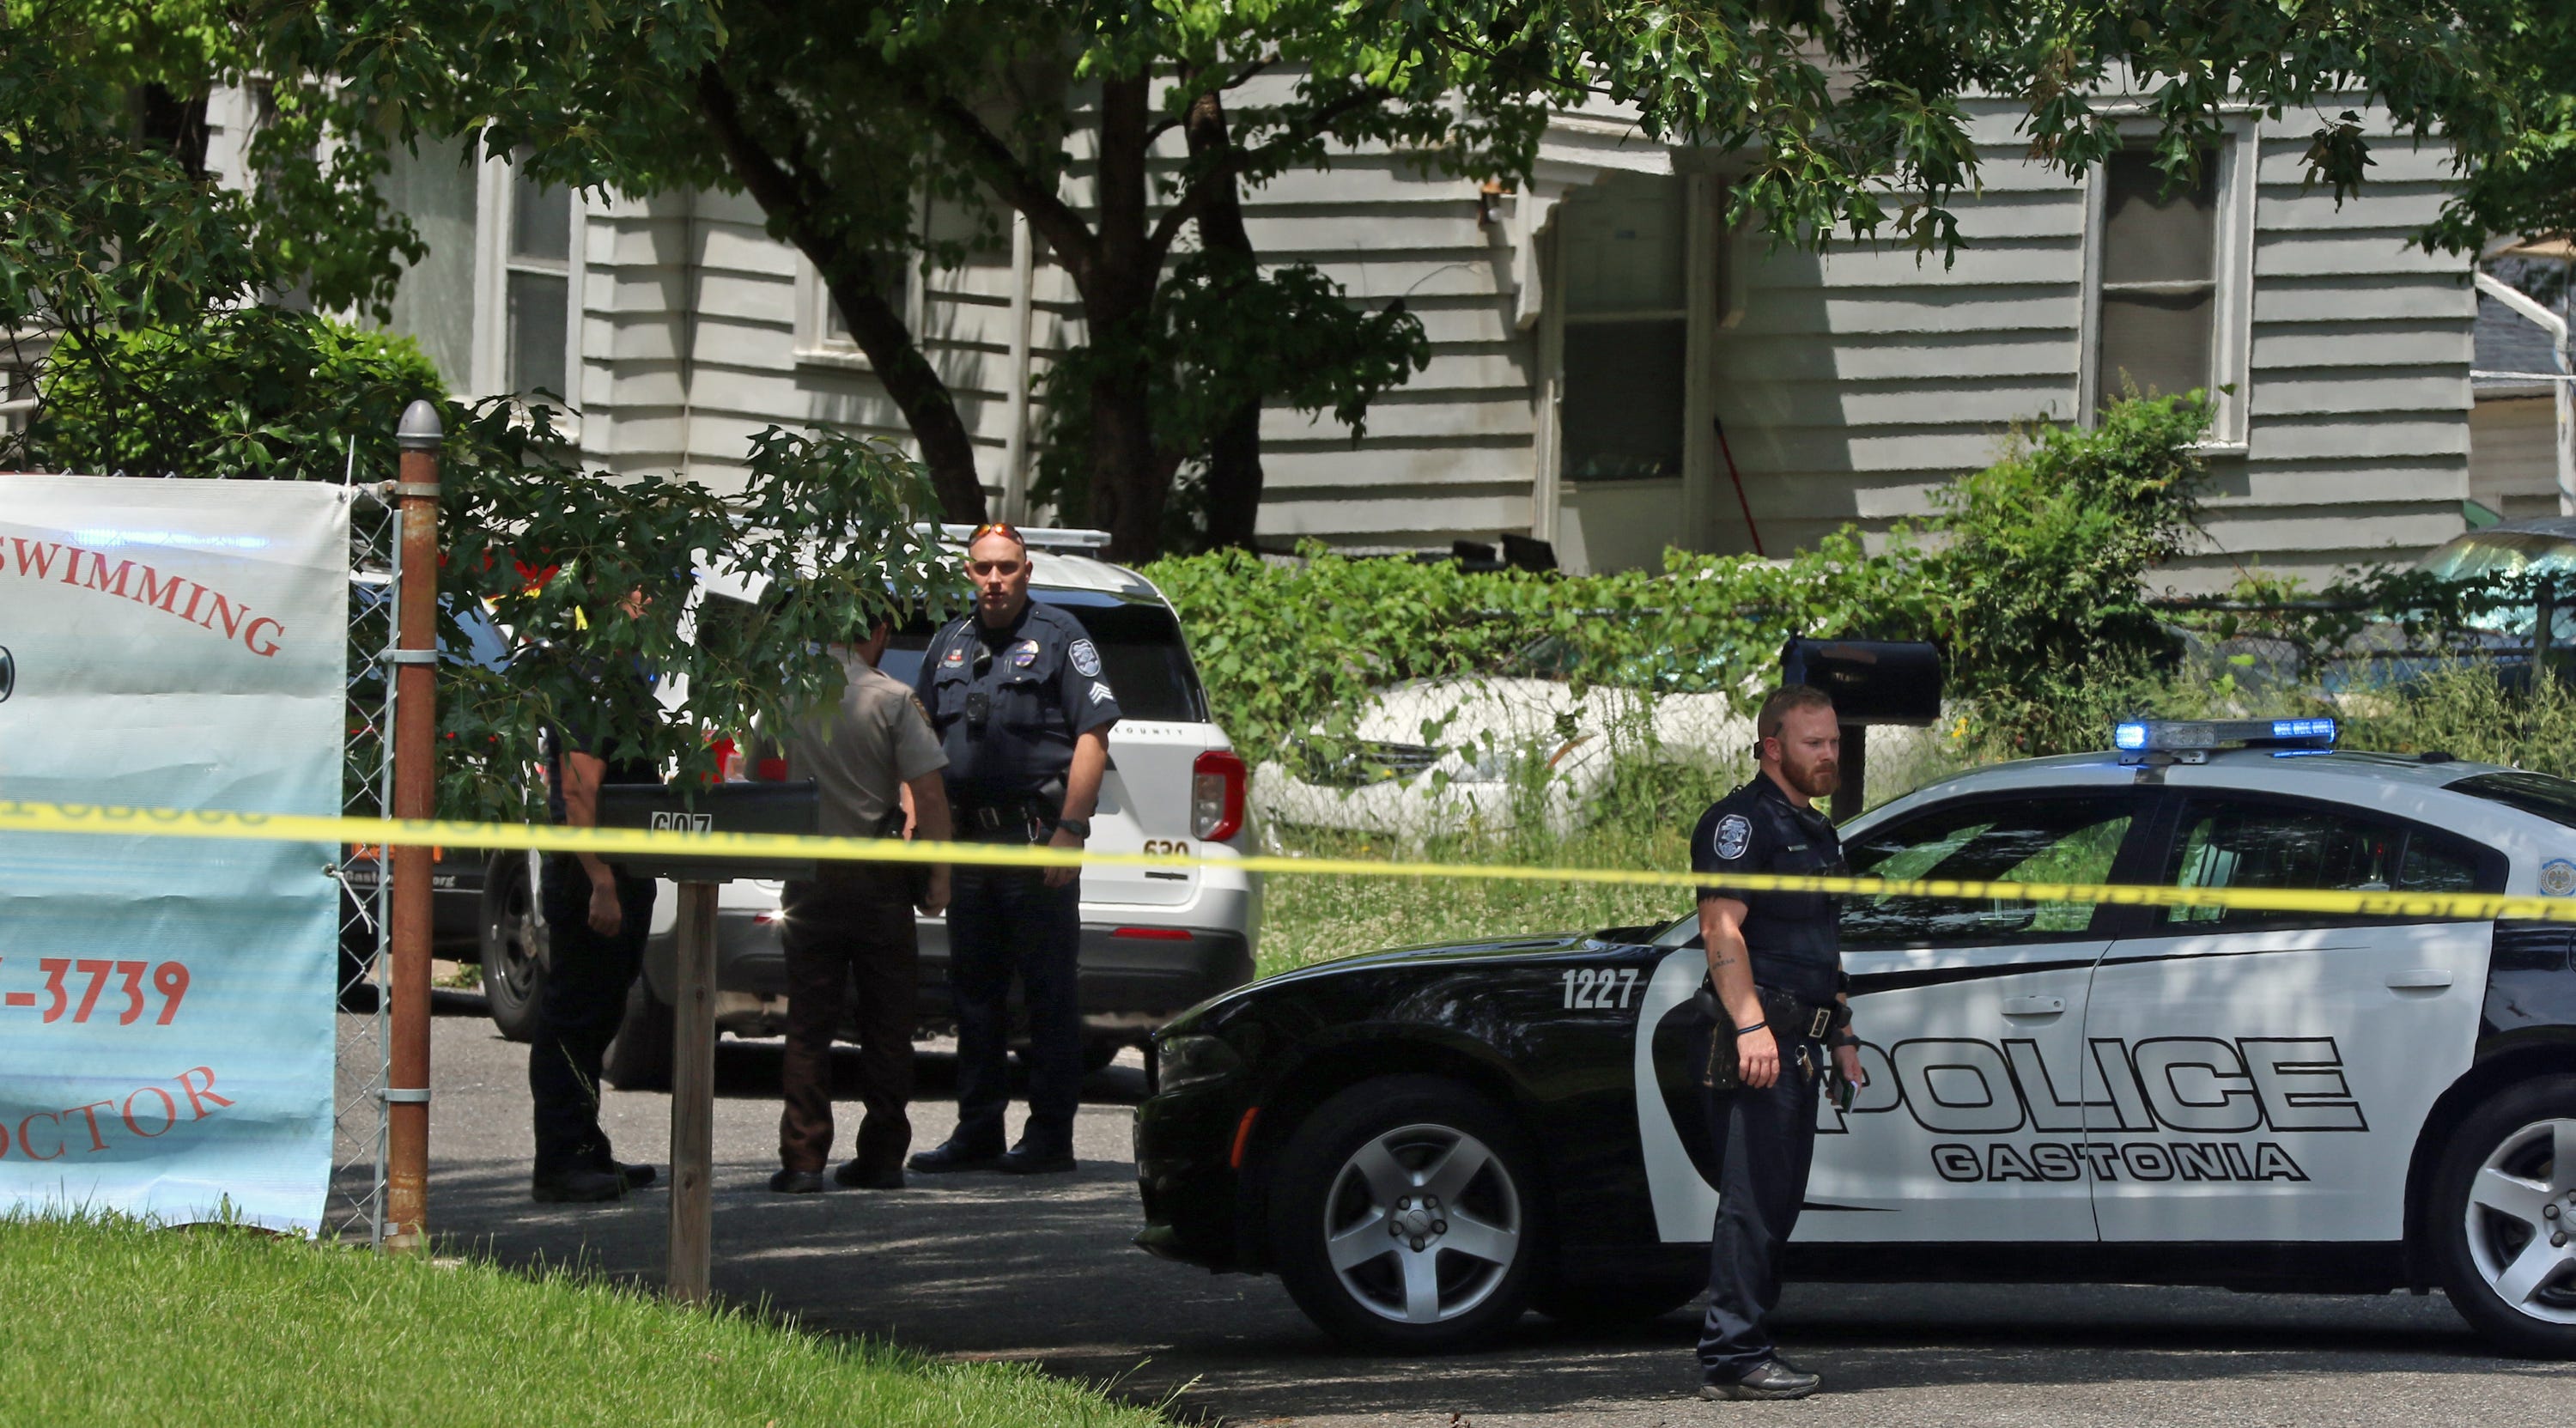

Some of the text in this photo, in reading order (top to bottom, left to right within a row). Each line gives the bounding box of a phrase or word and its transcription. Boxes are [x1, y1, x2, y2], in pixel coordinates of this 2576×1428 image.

[0, 536, 284, 658] WIMMING
[1114, 726, 1183, 735] COUNTY
[653, 813, 709, 836] 607
[1143, 839, 1189, 859] 630
[0, 957, 190, 1025] -3739
[1562, 968, 1639, 1008] 1227
[1814, 1036, 2370, 1134] POLICE
[0, 1066, 236, 1160] CTOR
[1930, 1142, 2311, 1182] GASTONIA
